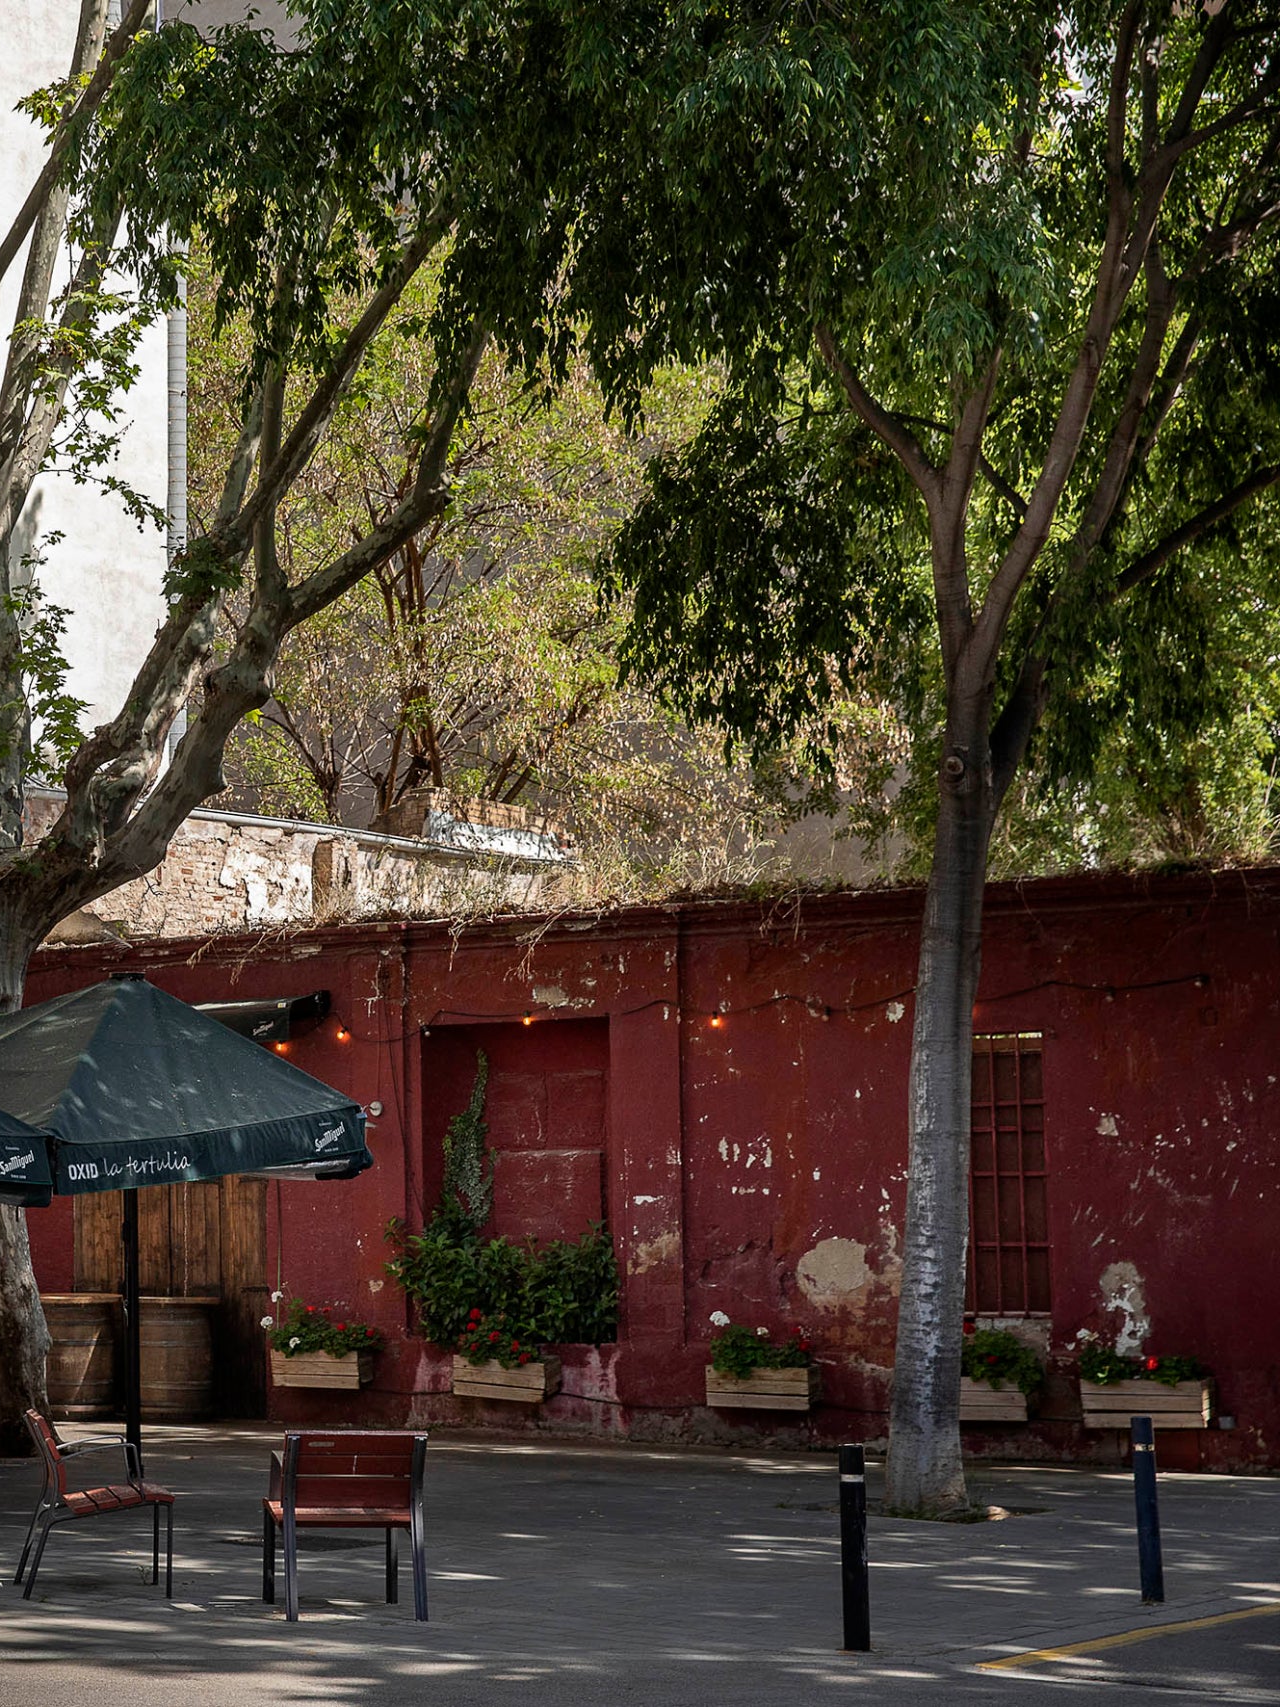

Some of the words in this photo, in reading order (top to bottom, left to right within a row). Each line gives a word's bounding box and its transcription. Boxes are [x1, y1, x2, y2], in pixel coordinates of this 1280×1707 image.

[68, 1163, 99, 1180] OXID
[103, 1158, 123, 1176] la
[126, 1151, 191, 1176] tertulia
